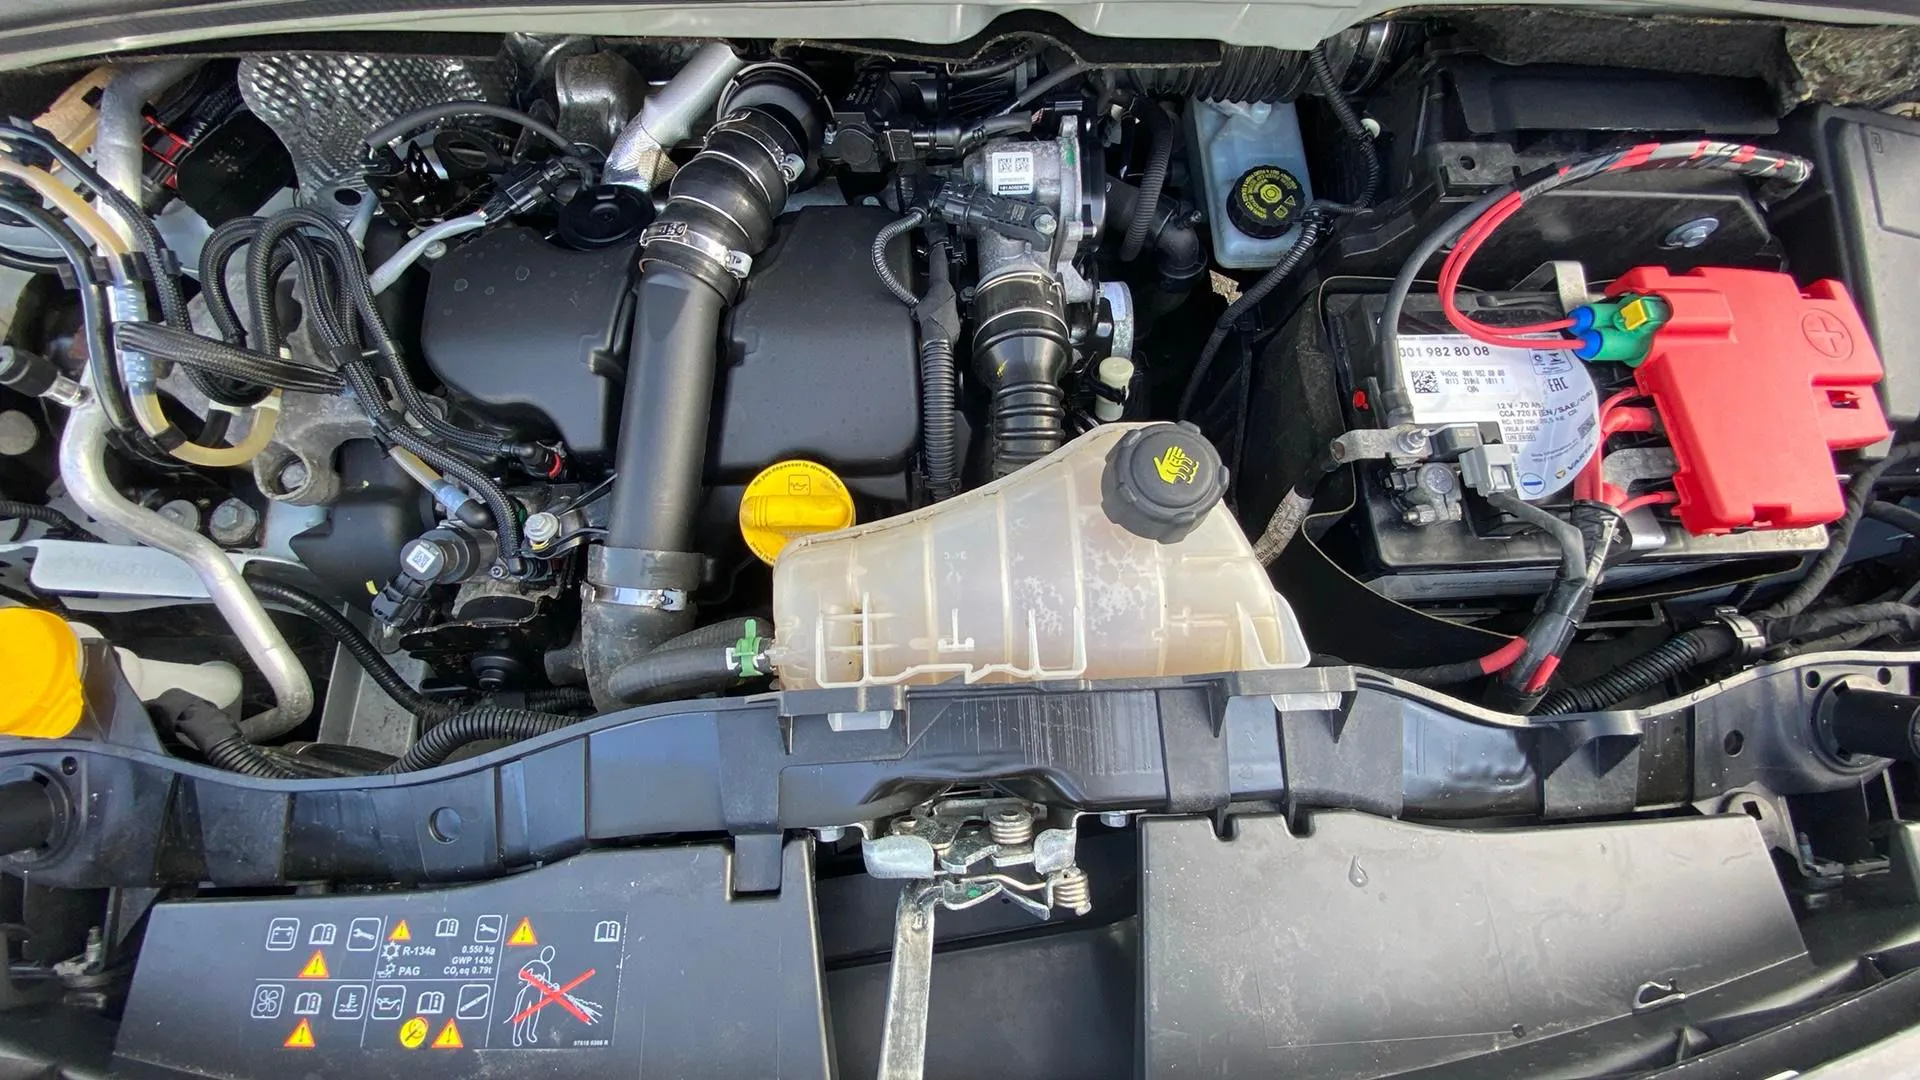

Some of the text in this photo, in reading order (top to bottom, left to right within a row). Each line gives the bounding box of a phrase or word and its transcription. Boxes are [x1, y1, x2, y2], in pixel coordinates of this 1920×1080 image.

[1426, 346, 1451, 357] 982
[1454, 346, 1470, 356] 80
[1473, 345, 1490, 356] 08
[1520, 401, 1530, 409] 70
[402, 945, 495, 956] R-134a 0.550 kg
[451, 956, 494, 965] GWP 1430
[398, 966, 421, 976] PAG
[471, 966, 492, 975] 0.79t
